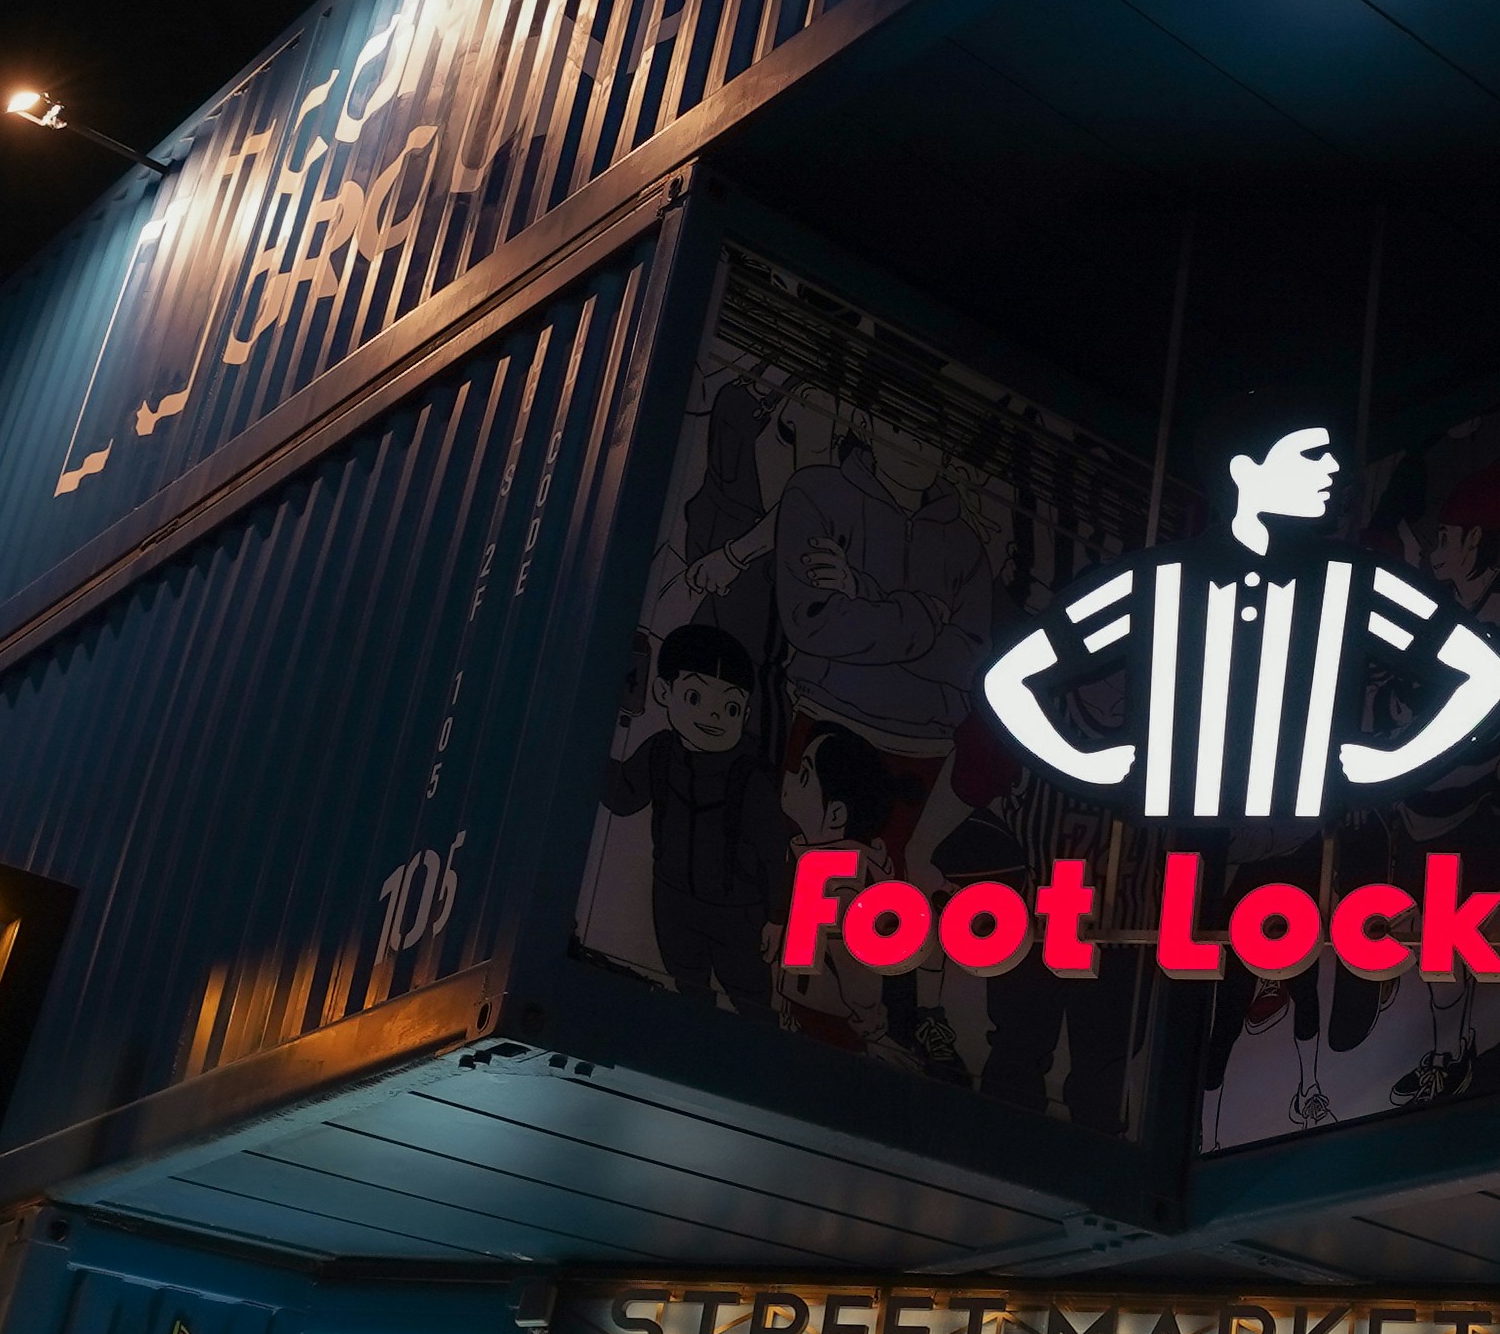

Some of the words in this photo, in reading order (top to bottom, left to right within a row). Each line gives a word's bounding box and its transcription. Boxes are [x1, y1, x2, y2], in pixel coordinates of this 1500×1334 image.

[514, 430, 563, 597] CODE
[469, 543, 496, 621] 2F
[425, 670, 462, 800] 105
[373, 830, 466, 965] 105
[782, 849, 1100, 979] Foot
